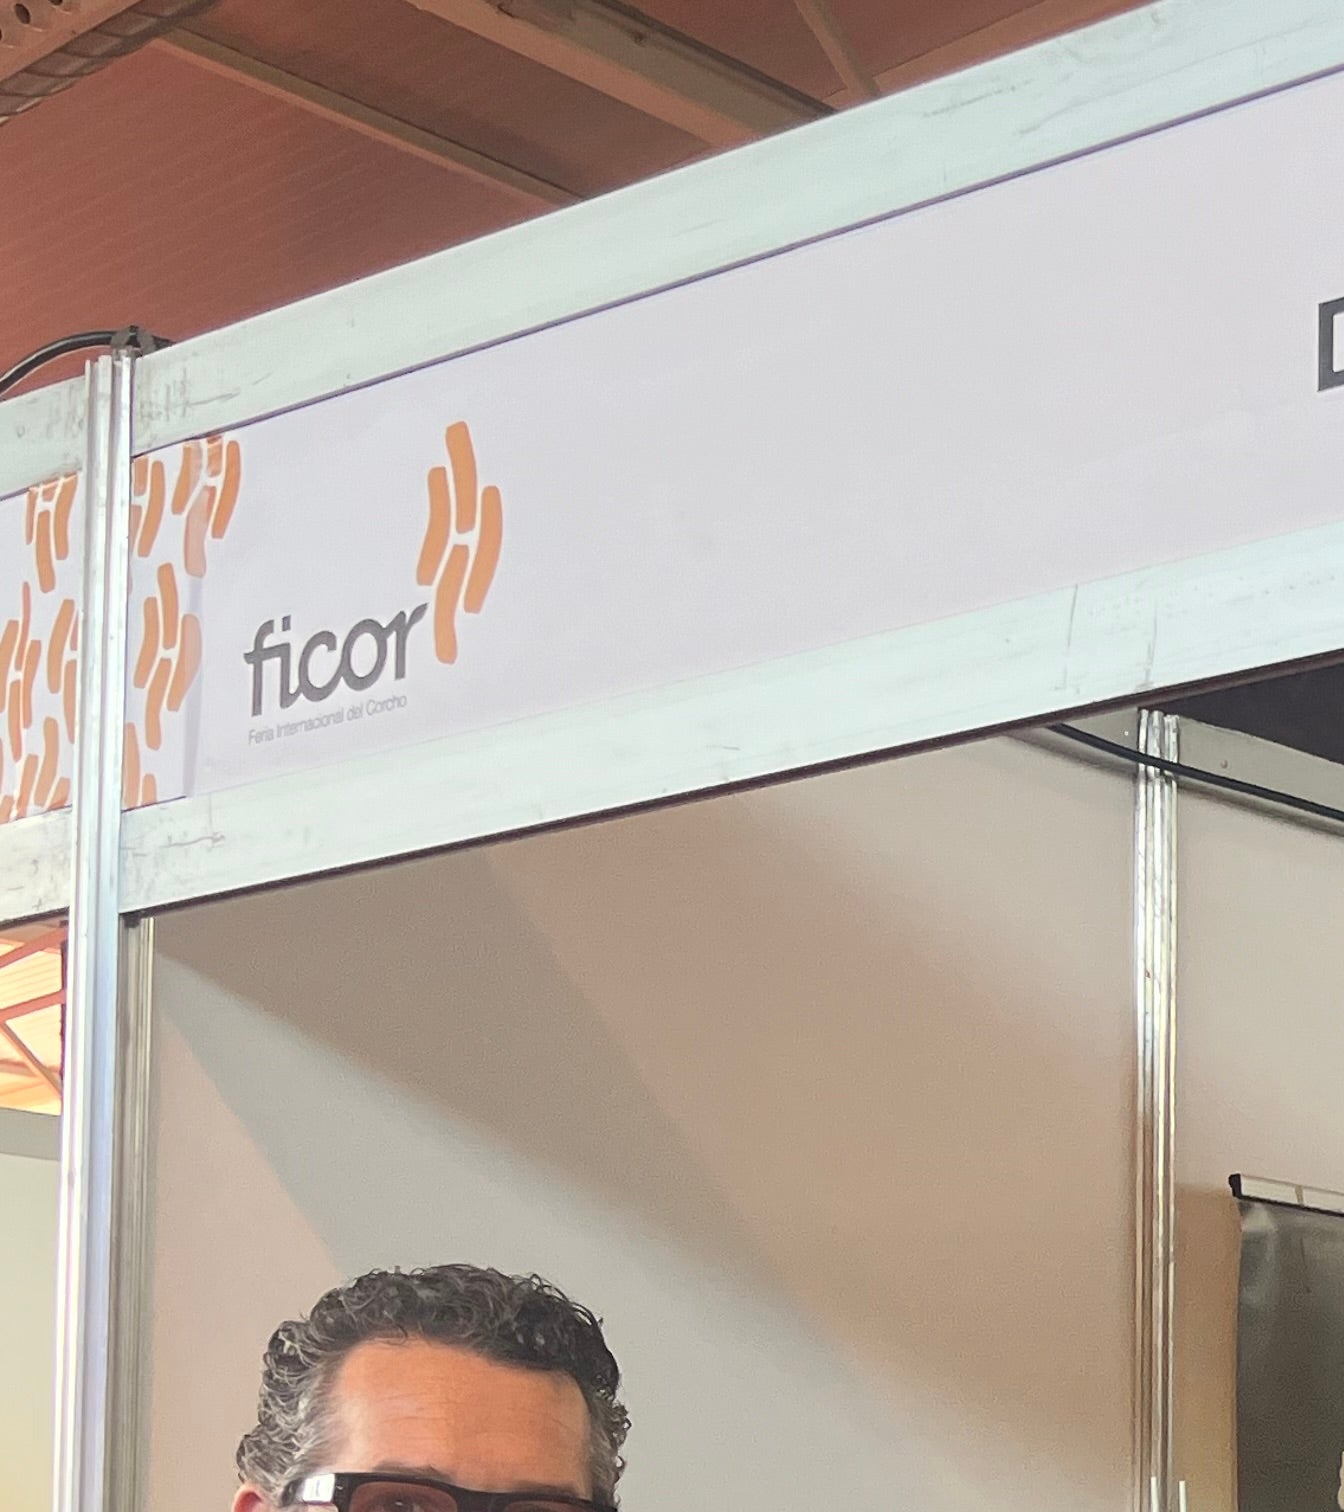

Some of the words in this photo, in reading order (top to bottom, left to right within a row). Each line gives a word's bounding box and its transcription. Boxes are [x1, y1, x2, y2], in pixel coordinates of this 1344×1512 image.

[242, 601, 430, 718] ficor
[248, 728, 275, 745] Feria
[276, 707, 344, 738] Internacional
[346, 702, 364, 721] del
[366, 694, 408, 717] Corcho
